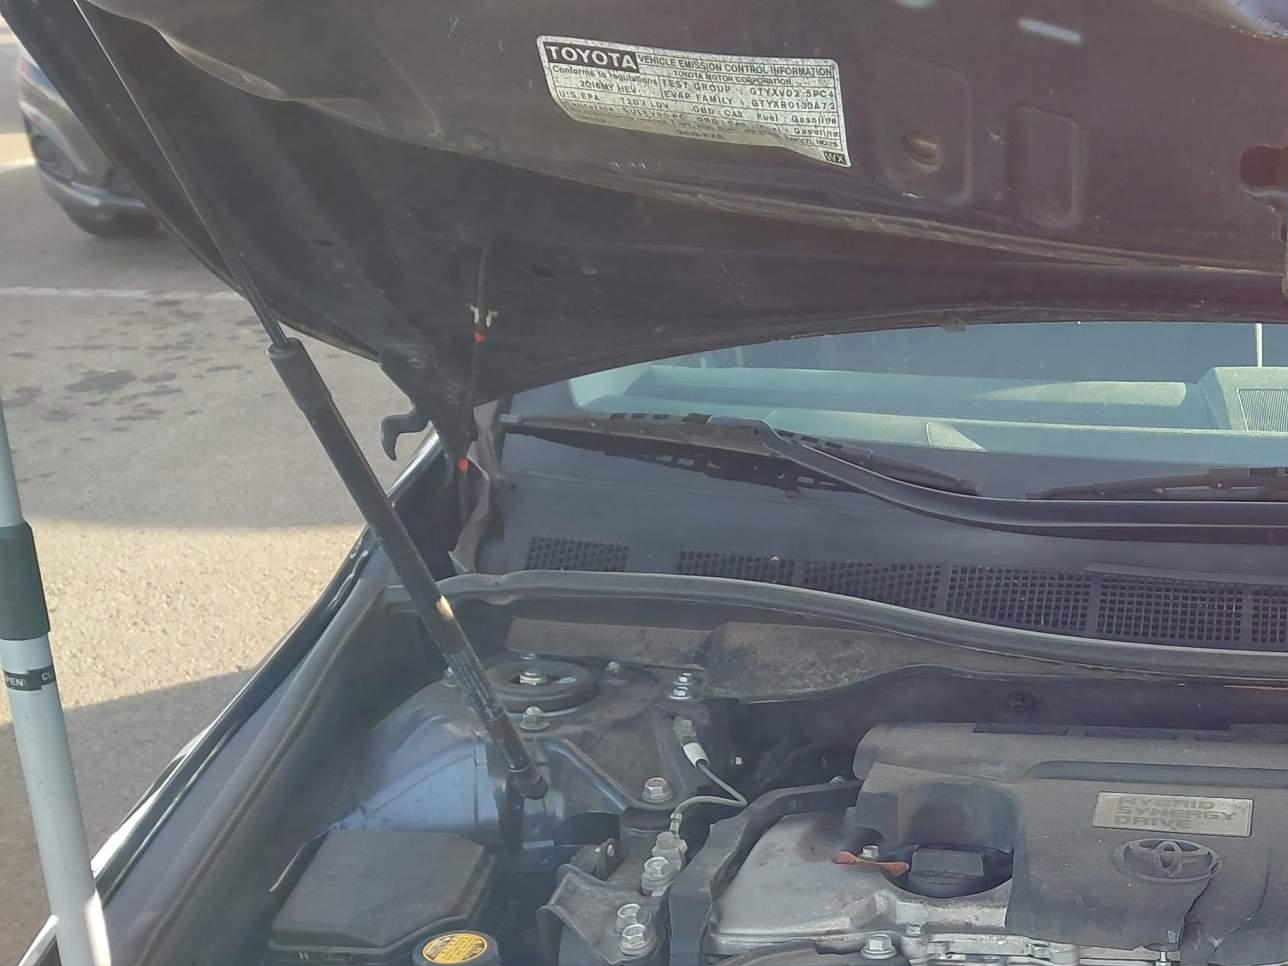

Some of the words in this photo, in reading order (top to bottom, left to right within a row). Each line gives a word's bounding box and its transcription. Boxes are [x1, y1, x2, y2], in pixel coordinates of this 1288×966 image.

[545, 45, 637, 70] TOYOTA
[638, 54, 677, 67] VEHICLE
[678, 59, 722, 71] EMISSION
[725, 63, 768, 74] CONTROL
[770, 66, 832, 77] INFORMATION
[552, 65, 596, 79] Conforms
[597, 71, 607, 79] to
[609, 72, 658, 85] regulations
[672, 70, 703, 79] TOYOTA
[705, 73, 734, 82] MOTOR
[735, 76, 792, 85] CORPORATION
[618, 84, 637, 94] HEV
[661, 79, 688, 89] TEST
[694, 83, 731, 92] GROUP
[663, 90, 691, 100] EVAP
[696, 95, 732, 105] FAMILY
[791, 115, 838, 126] Gasoline
[1118, 797, 1215, 810] HYBRID
[1114, 806, 1237, 821] SYNERGY
[1113, 815, 1193, 829] DRIVE
